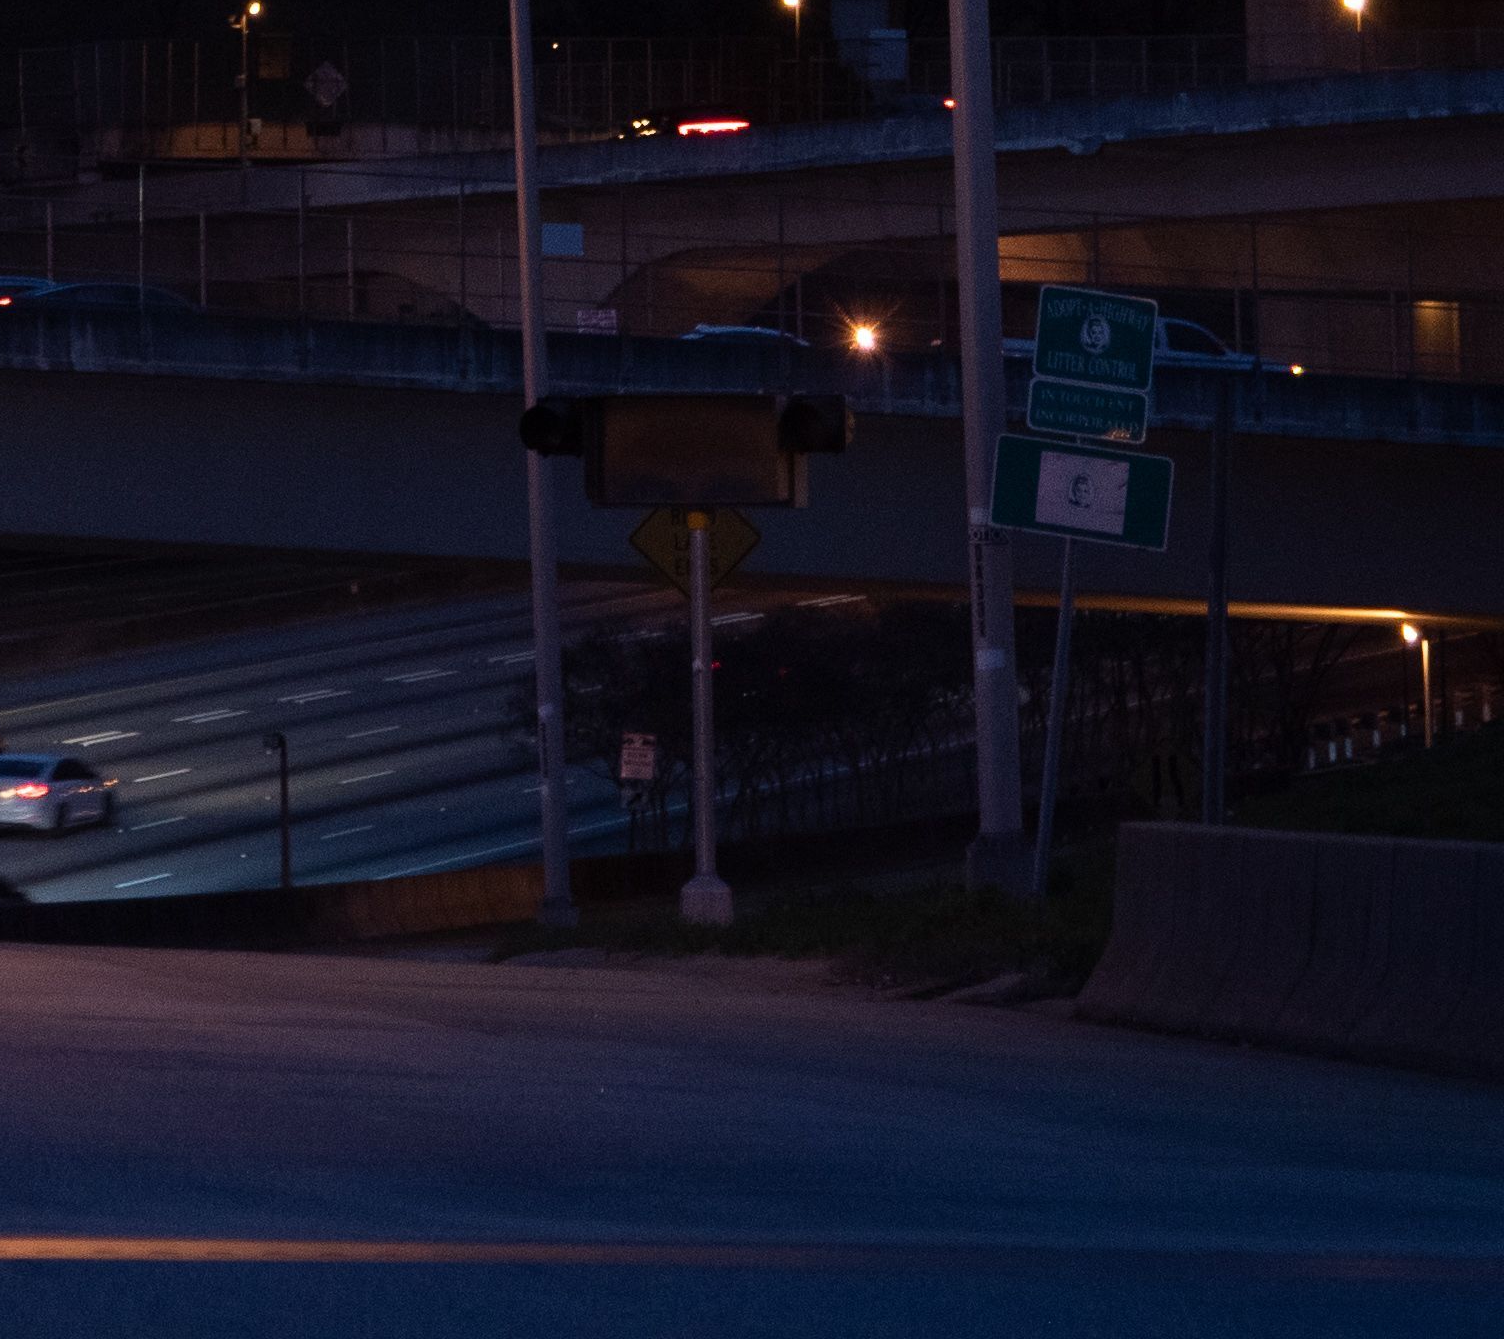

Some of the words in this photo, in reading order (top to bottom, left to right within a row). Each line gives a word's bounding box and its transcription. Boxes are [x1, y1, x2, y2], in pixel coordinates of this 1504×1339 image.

[1046, 350, 1085, 374] LITTER
[1087, 359, 1138, 381] CONTROL
[674, 532, 718, 551] LE
[675, 558, 719, 576] ES
